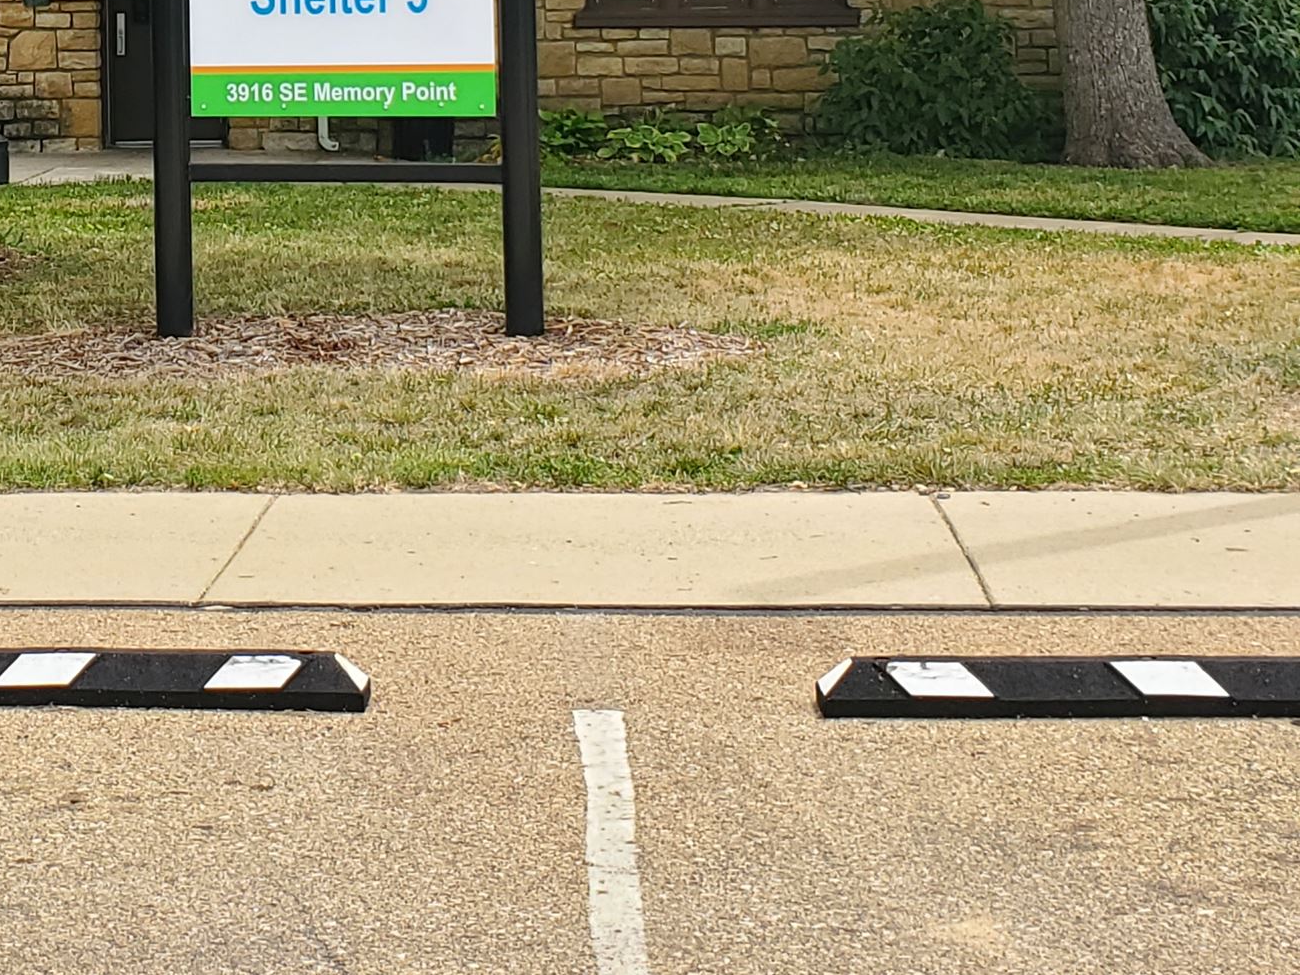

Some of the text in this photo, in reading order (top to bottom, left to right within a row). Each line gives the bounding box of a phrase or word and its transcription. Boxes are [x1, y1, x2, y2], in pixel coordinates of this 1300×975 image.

[226, 81, 457, 107] 3916 SE Memory Point
